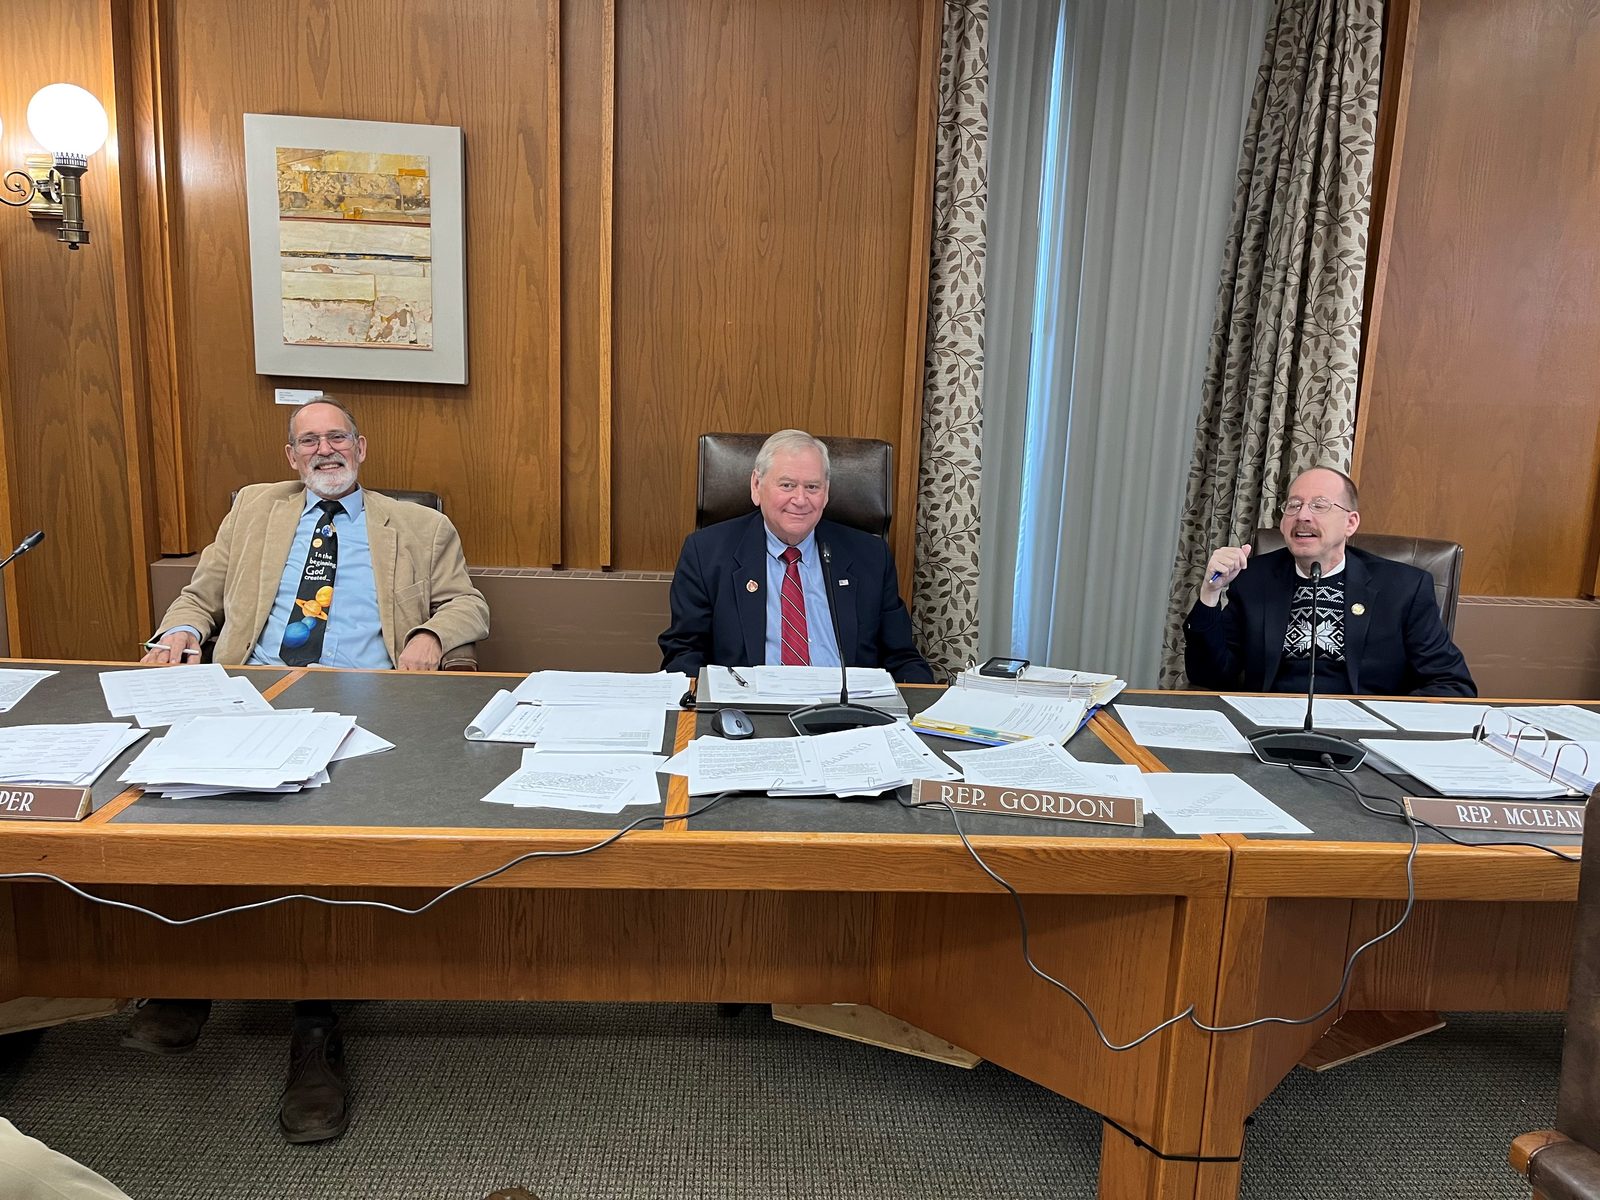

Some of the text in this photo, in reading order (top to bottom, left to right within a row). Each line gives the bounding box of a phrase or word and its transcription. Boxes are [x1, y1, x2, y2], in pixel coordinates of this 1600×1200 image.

[305, 565, 325, 575] God
[940, 785, 1115, 818] REP. GORDON
[1456, 804, 1582, 828] REP. MCLEAN
